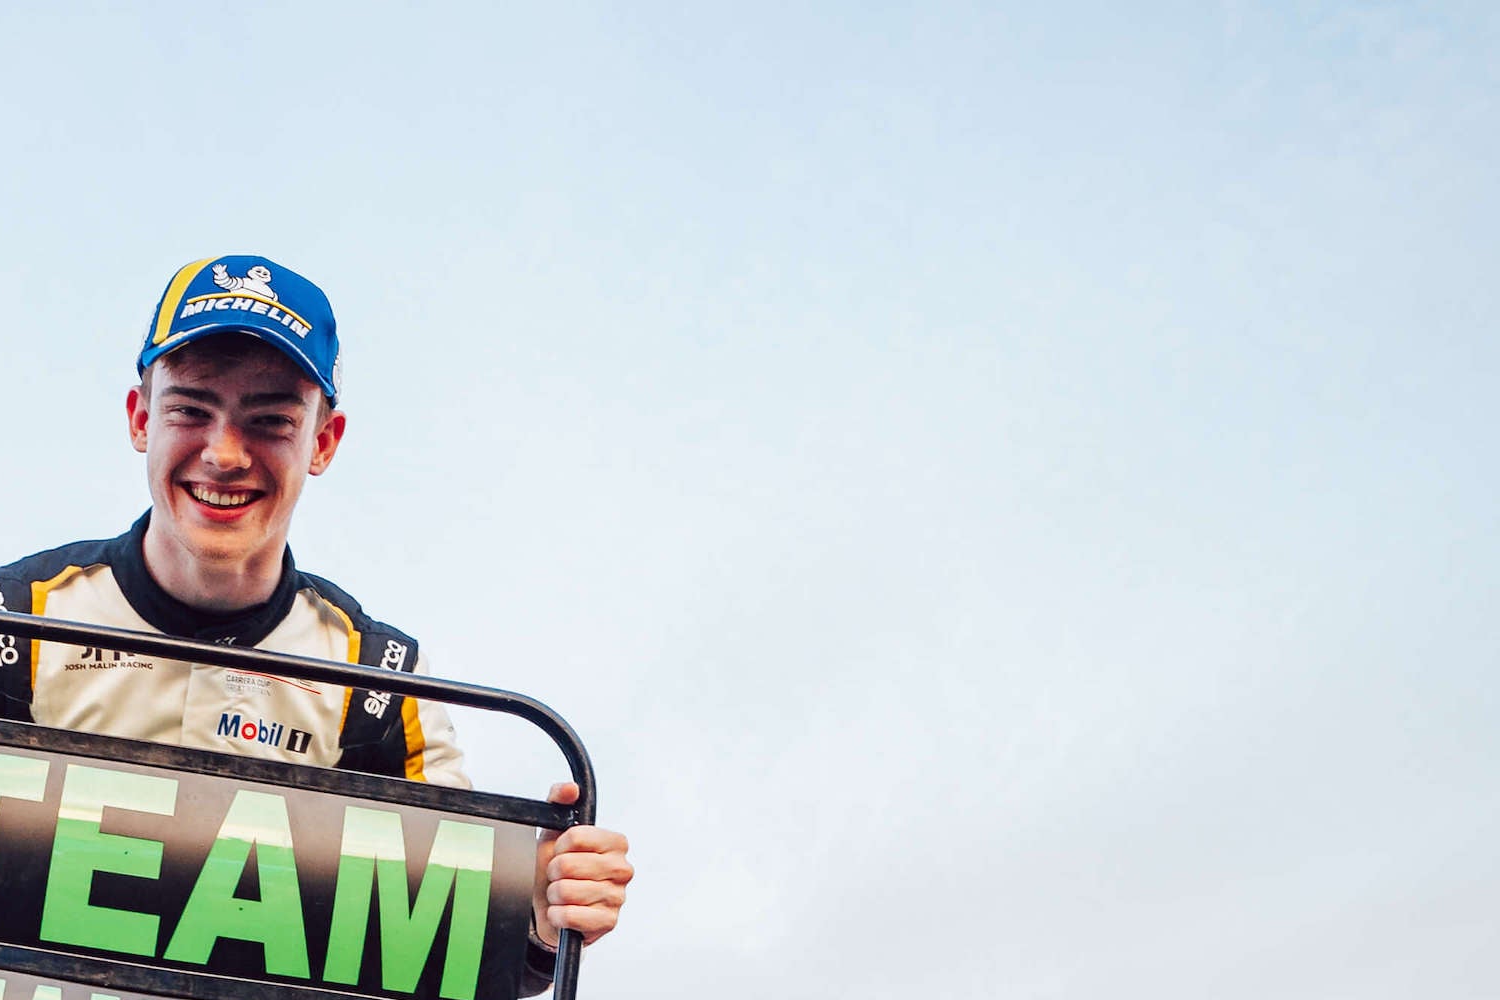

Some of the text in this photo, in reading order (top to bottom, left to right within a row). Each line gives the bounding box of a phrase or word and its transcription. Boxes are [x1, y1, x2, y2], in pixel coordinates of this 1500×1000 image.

[180, 297, 311, 339] MICHELIN
[64, 661, 153, 671] JOSH MALIN RACING
[364, 639, 407, 719] sprco
[217, 713, 284, 747] Mobil
